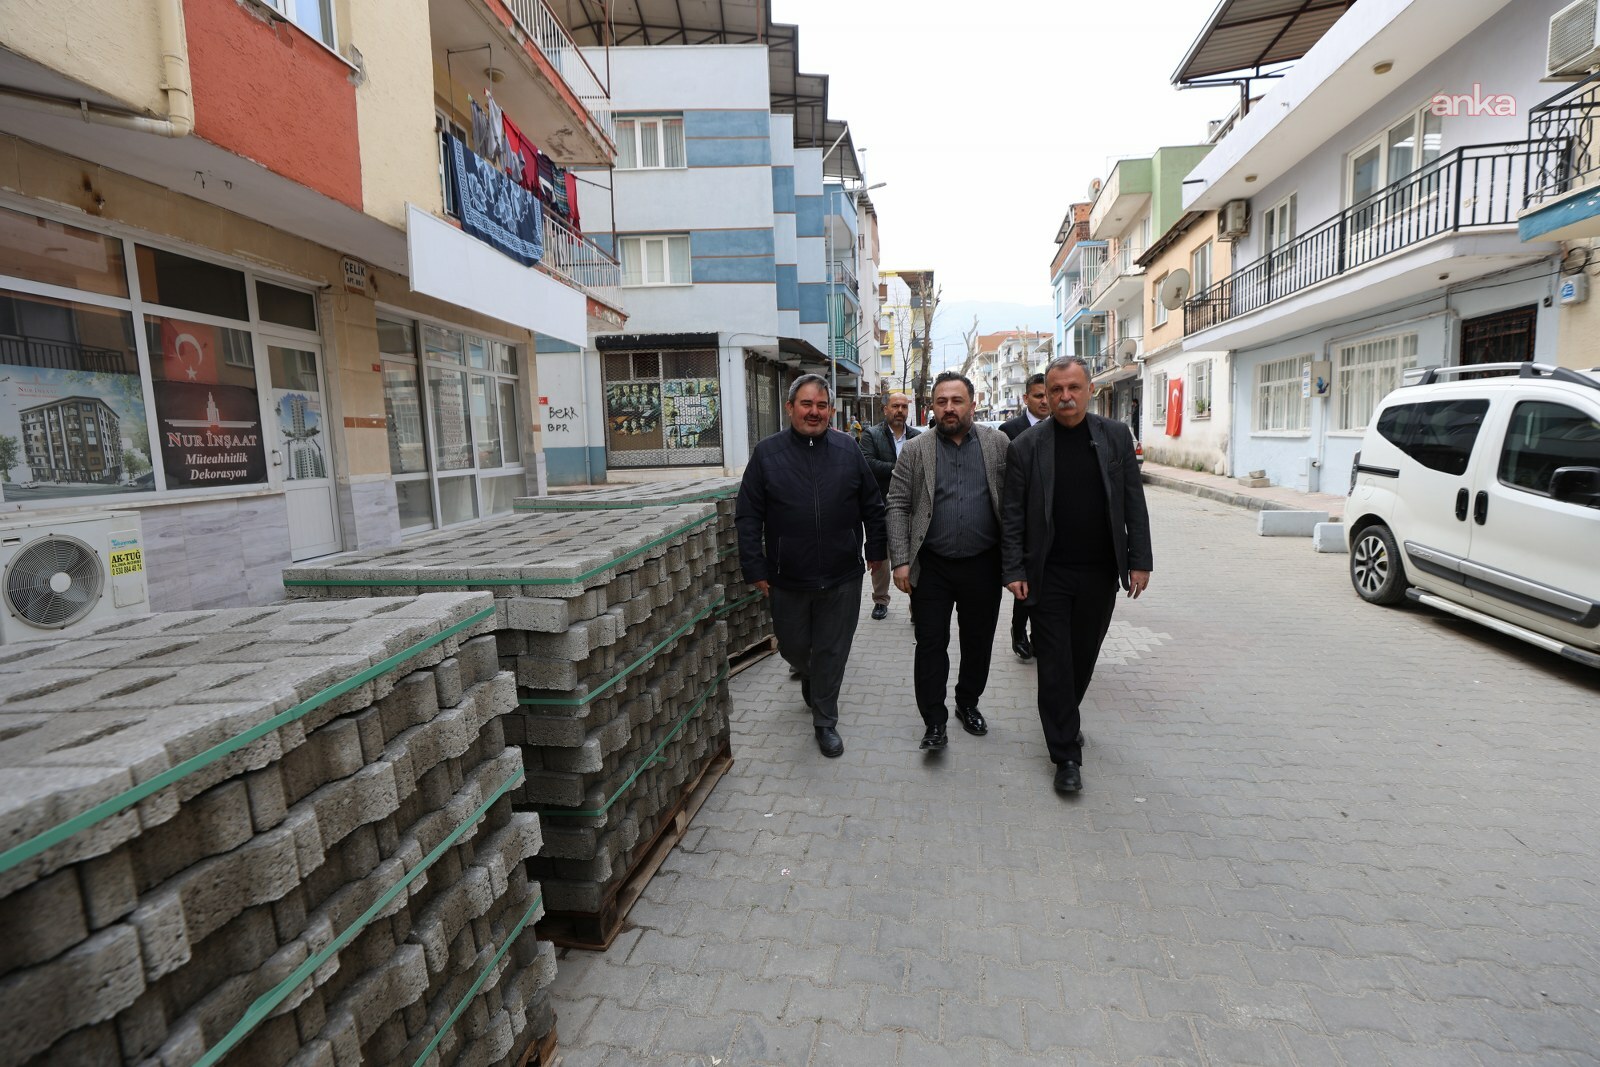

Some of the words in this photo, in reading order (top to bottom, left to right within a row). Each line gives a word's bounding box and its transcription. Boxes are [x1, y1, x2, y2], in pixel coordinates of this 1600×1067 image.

[344, 261, 365, 277] ÇELİK
[547, 423, 570, 433] BPR
[166, 432, 205, 447] NUR
[206, 430, 257, 449] İNŞAAT
[185, 452, 248, 465] Müteahhitlik
[189, 468, 247, 480] Dekorasyon
[111, 549, 141, 563] AK-TUĞ
